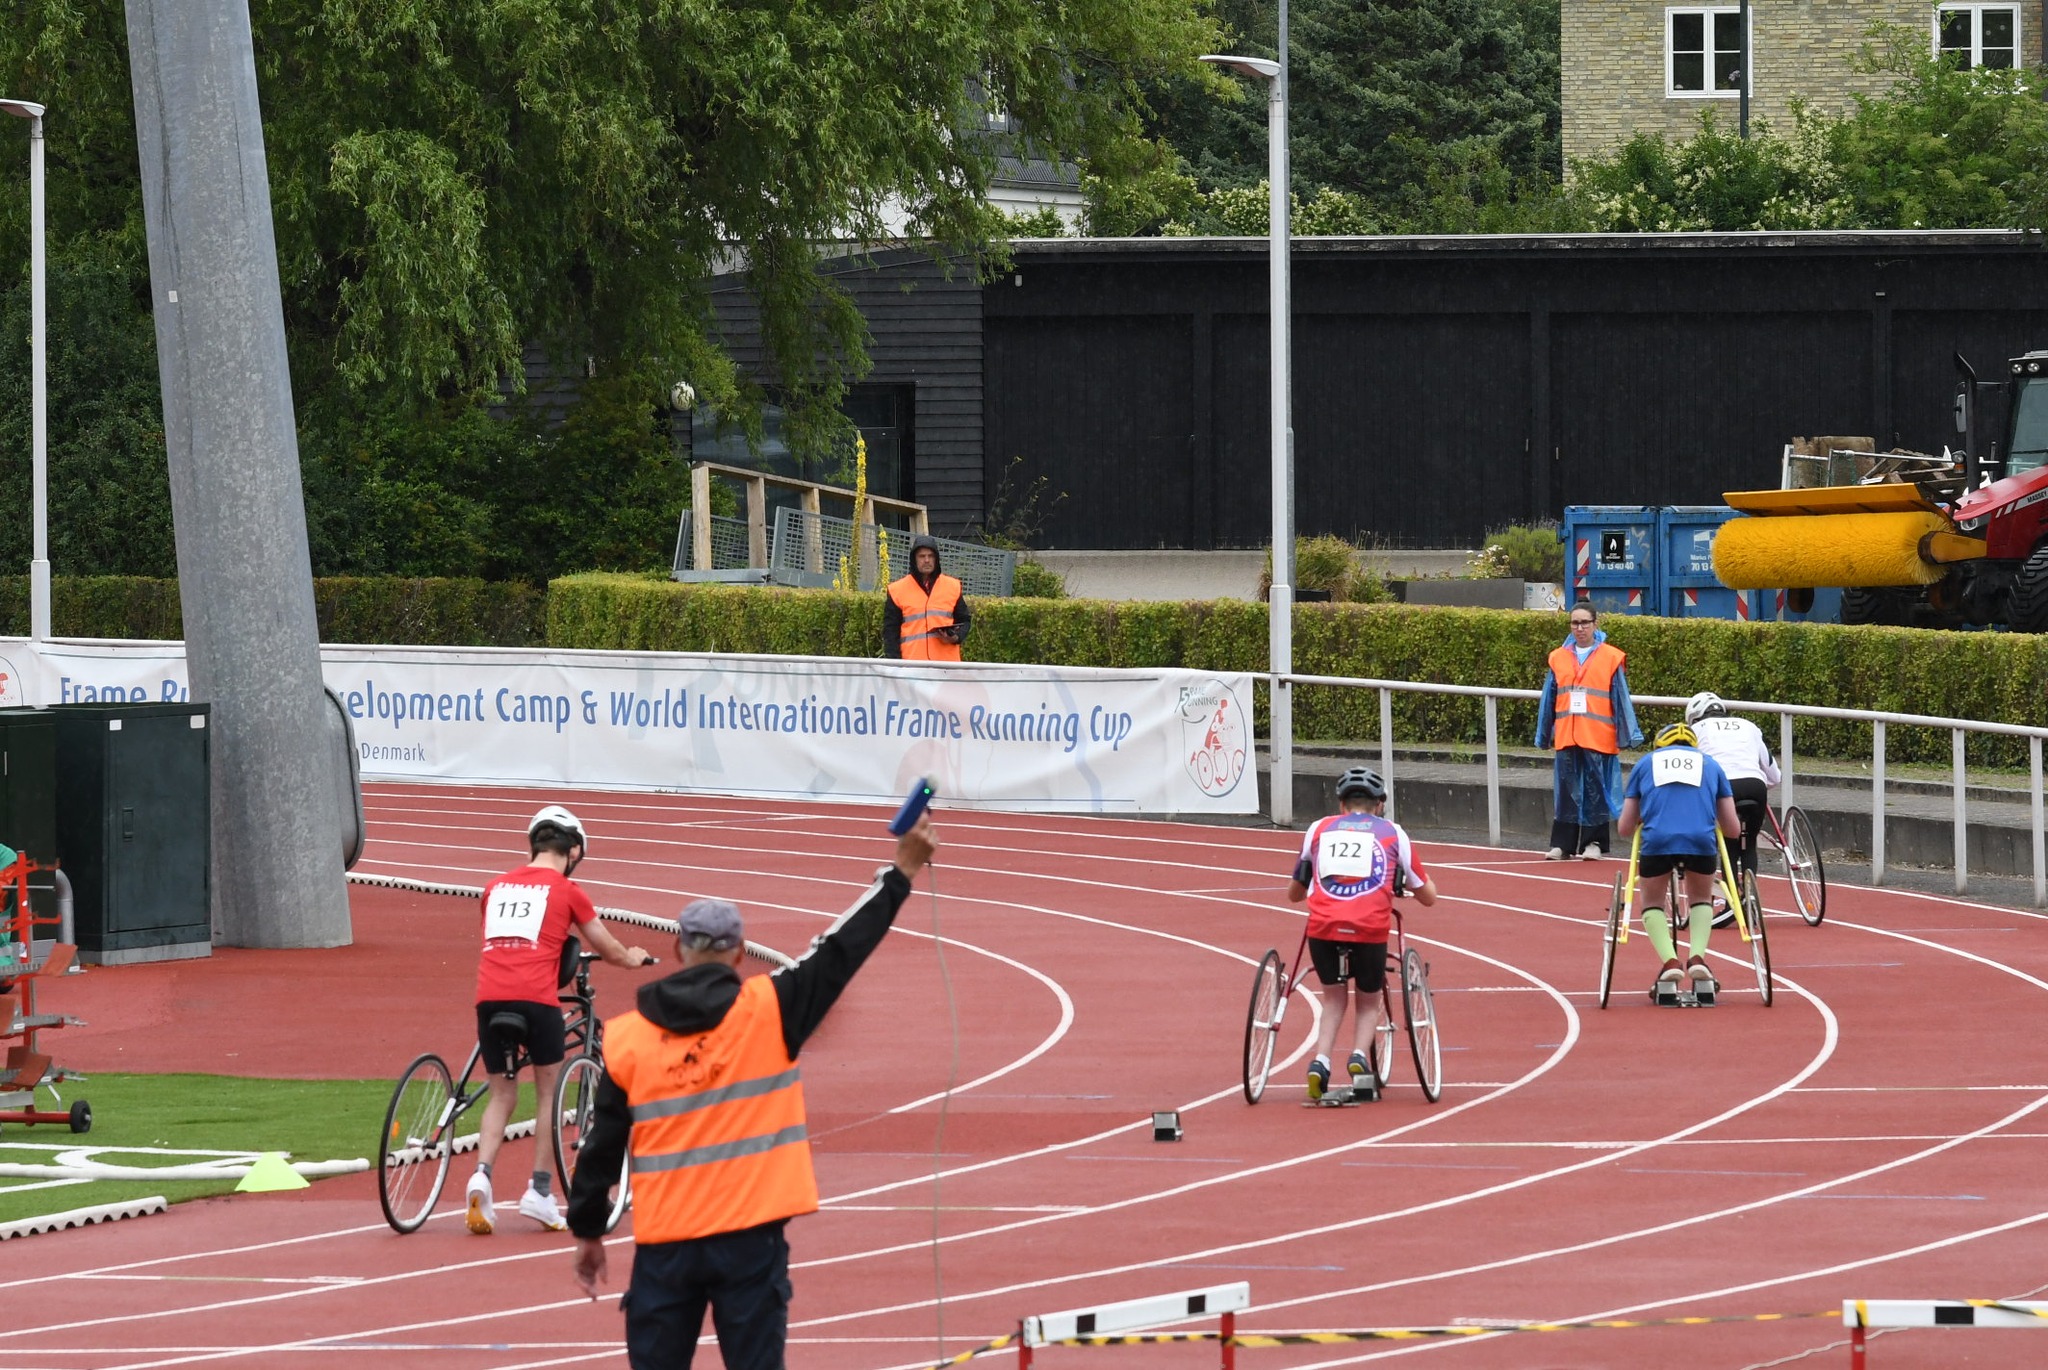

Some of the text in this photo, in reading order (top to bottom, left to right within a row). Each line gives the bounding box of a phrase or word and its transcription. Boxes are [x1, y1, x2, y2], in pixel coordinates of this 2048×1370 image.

[1691, 563, 1700, 571] 70
[1701, 563, 1709, 571] 13
[496, 688, 571, 733] Camp
[581, 690, 598, 725] &
[610, 688, 687, 728] World
[699, 694, 877, 735] International
[885, 700, 962, 739] Frame
[969, 702, 1080, 753] Running
[1090, 705, 1132, 752] Cup
[1713, 721, 1740, 730] 125
[361, 742, 426, 761] Denmark
[1663, 757, 1693, 770] 108
[1329, 842, 1362, 858] 122
[497, 901, 531, 918] 113
